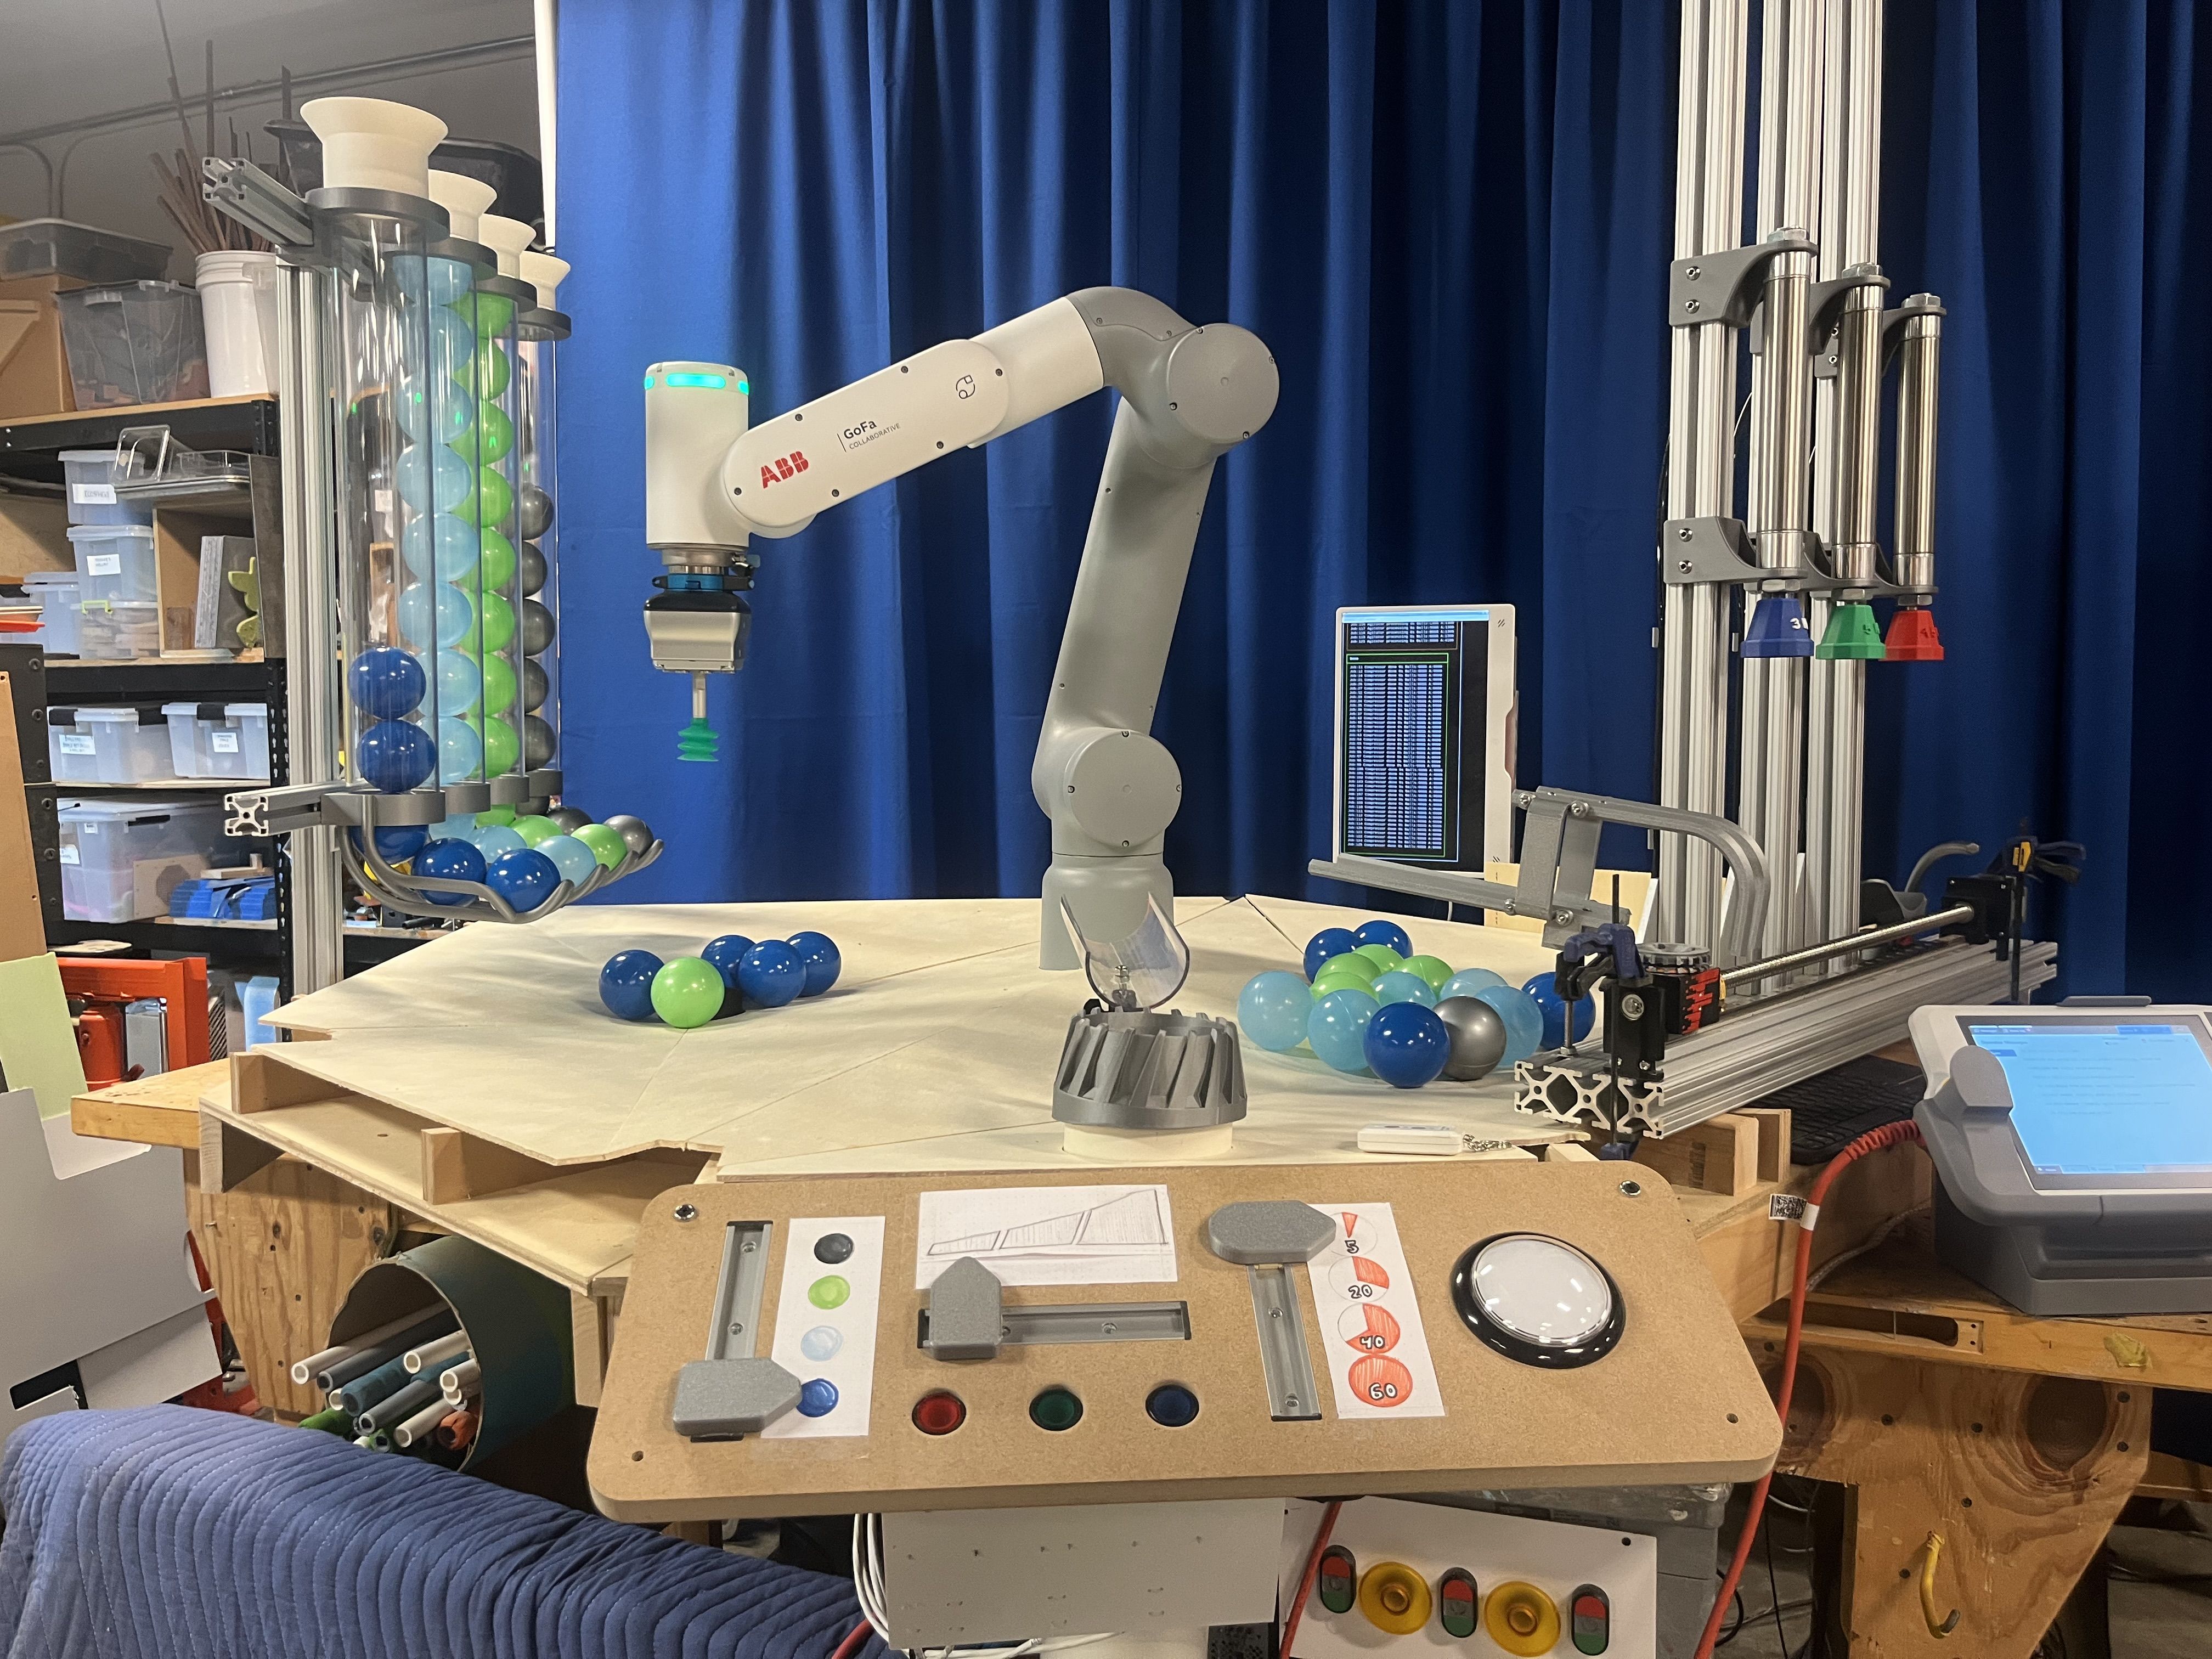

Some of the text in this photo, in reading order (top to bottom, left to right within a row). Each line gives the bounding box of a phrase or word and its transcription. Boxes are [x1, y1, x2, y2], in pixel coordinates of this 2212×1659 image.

[844, 421, 877, 439] GoFa
[849, 422, 901, 450] COLLABORATIVE
[760, 450, 809, 489] ABB
[1344, 1239, 1359, 1254] 5
[1347, 1284, 1373, 1299] 20
[1359, 1335, 1386, 1350] 40
[1368, 1382, 1398, 1401] 60
